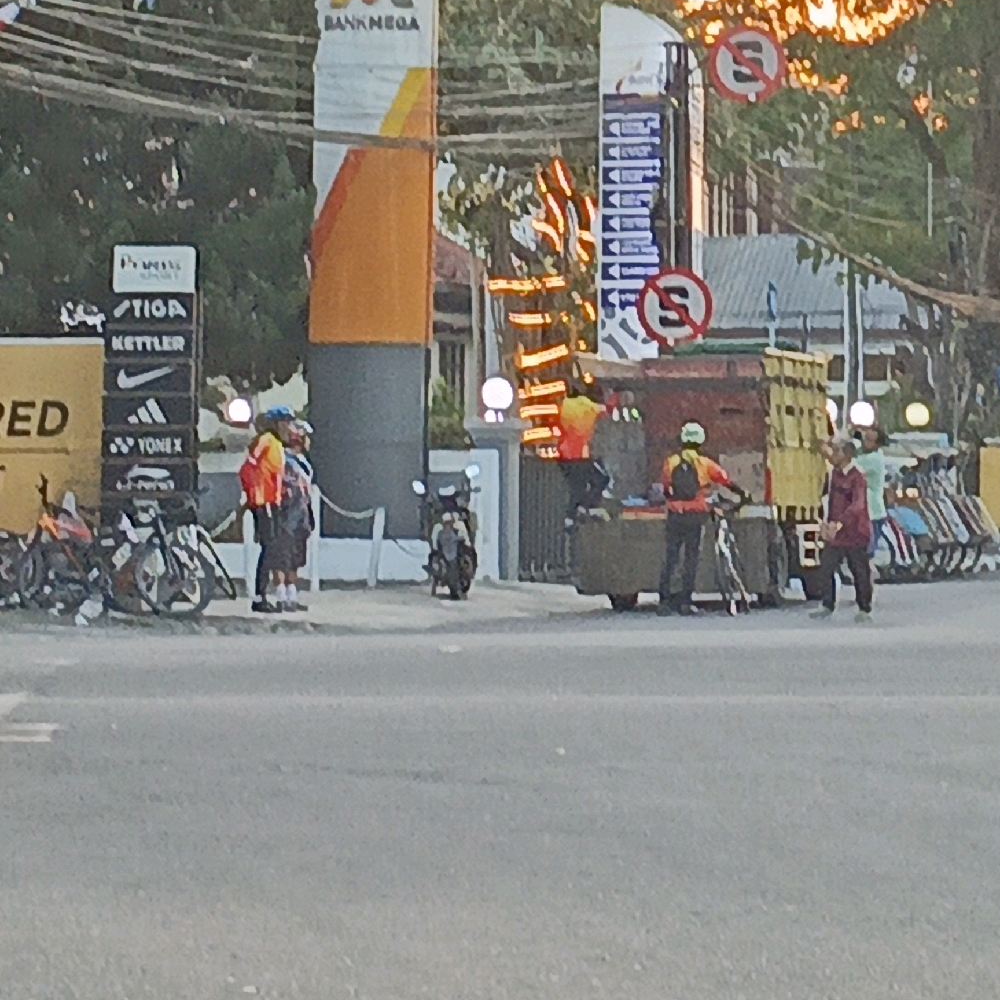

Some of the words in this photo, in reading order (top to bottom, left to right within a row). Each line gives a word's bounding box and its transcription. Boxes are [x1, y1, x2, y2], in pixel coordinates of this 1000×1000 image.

[112, 335, 186, 351] KETTLER
[0, 400, 69, 437] ED
[138, 437, 183, 454] YONEX
